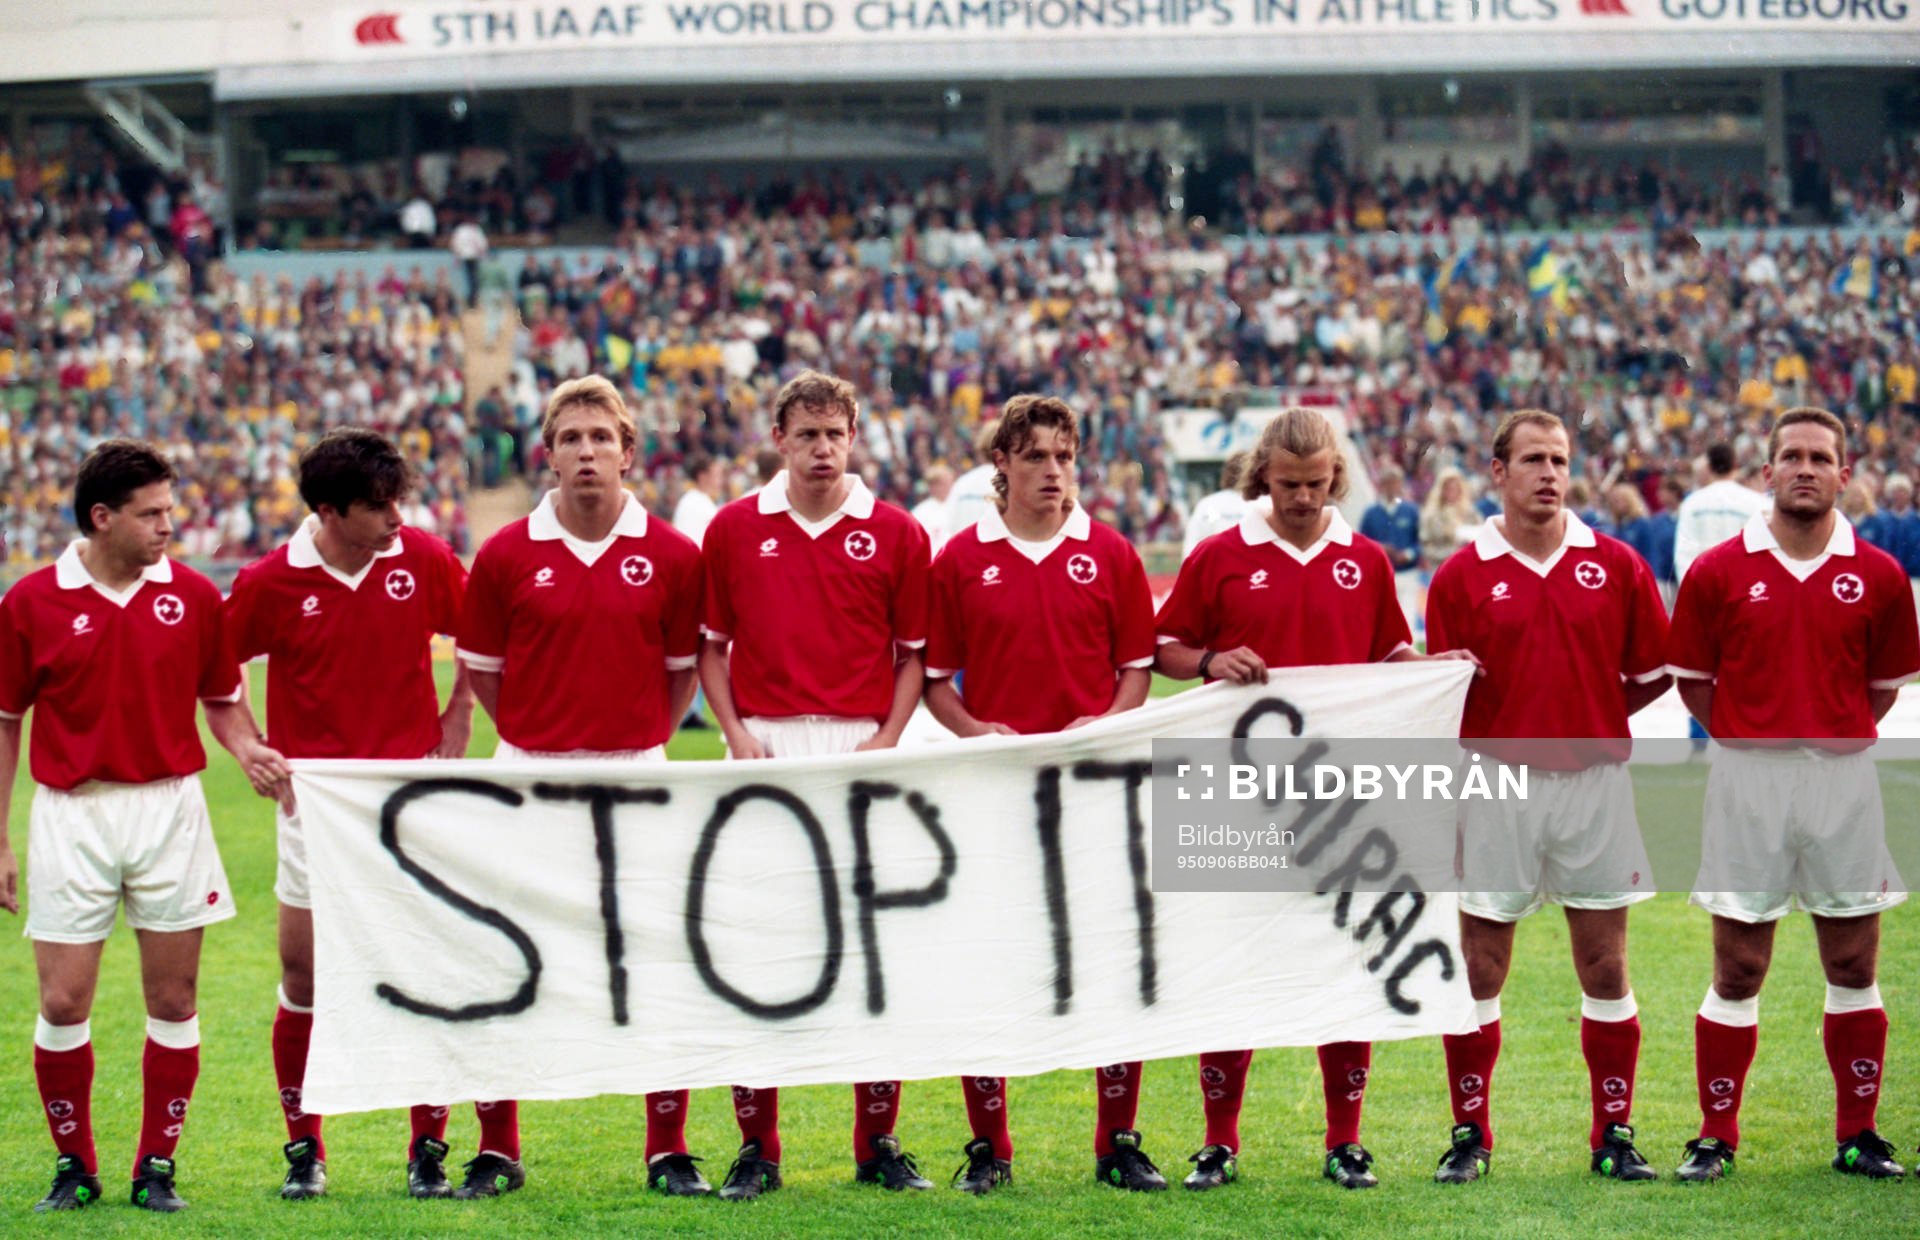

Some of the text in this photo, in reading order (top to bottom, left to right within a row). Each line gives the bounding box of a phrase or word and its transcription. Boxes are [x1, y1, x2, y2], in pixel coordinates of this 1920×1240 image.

[432, 0, 1560, 46] 5TH IAAF WORLD CHAMPIONSHIPS IN ATHLETICS
[375, 758, 1190, 1026] STOP IT
[1230, 696, 1456, 1016] CHIRAC
